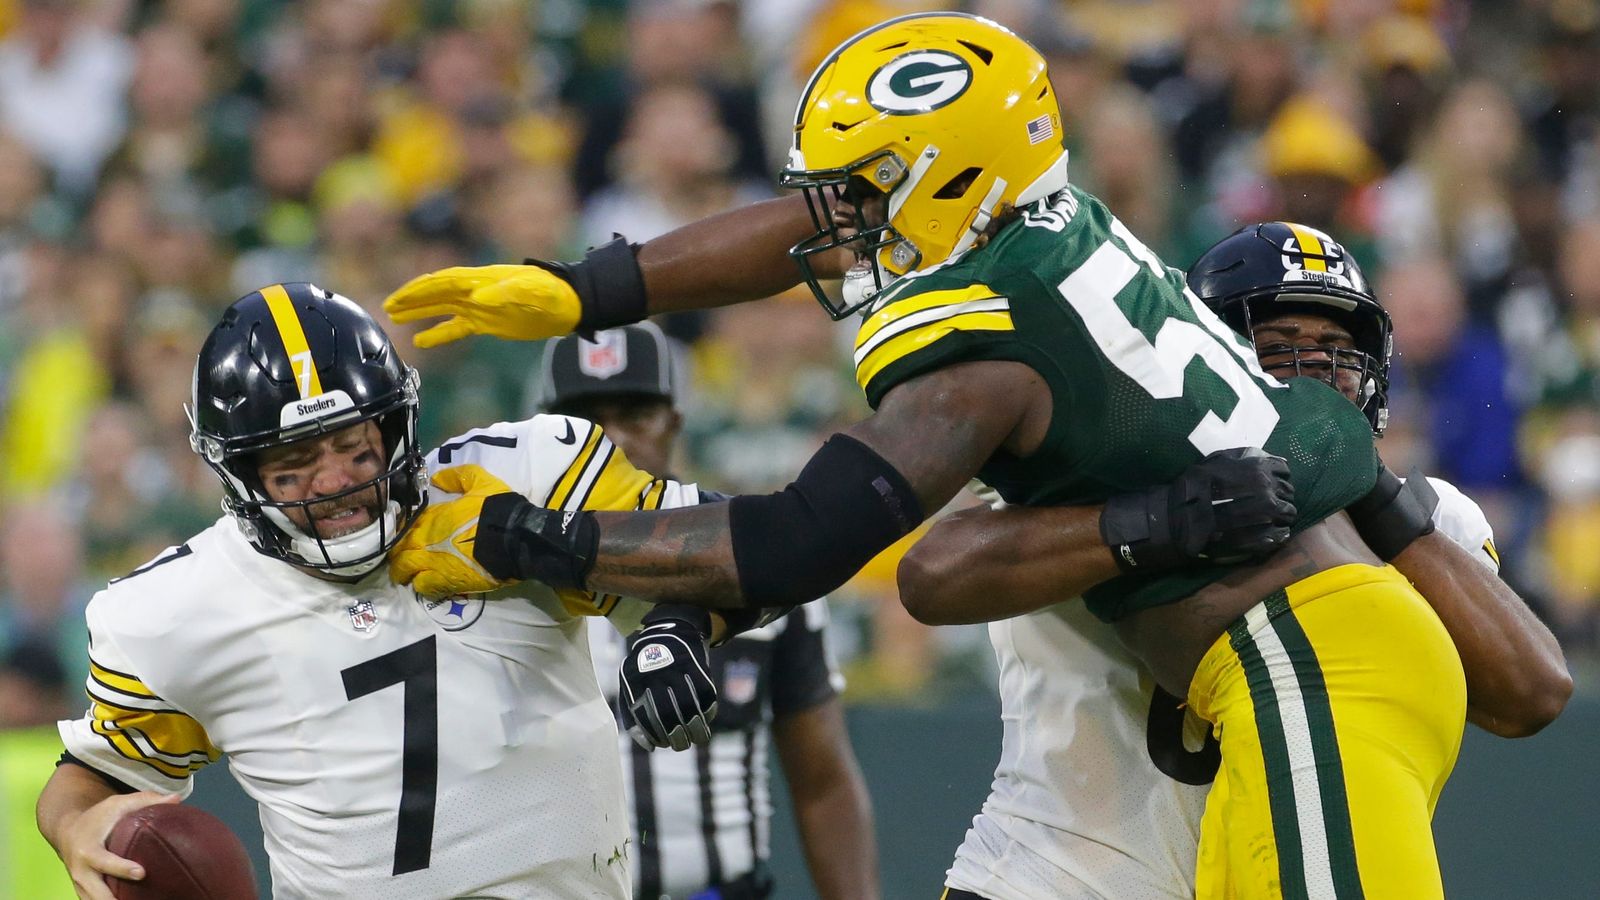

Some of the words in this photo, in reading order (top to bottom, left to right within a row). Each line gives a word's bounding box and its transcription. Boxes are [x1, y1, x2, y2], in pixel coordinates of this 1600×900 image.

[866, 50, 972, 114] G
[1301, 271, 1339, 285] Steelers
[290, 350, 313, 400] 7
[296, 398, 336, 416] Steelers
[340, 634, 438, 877] 7
